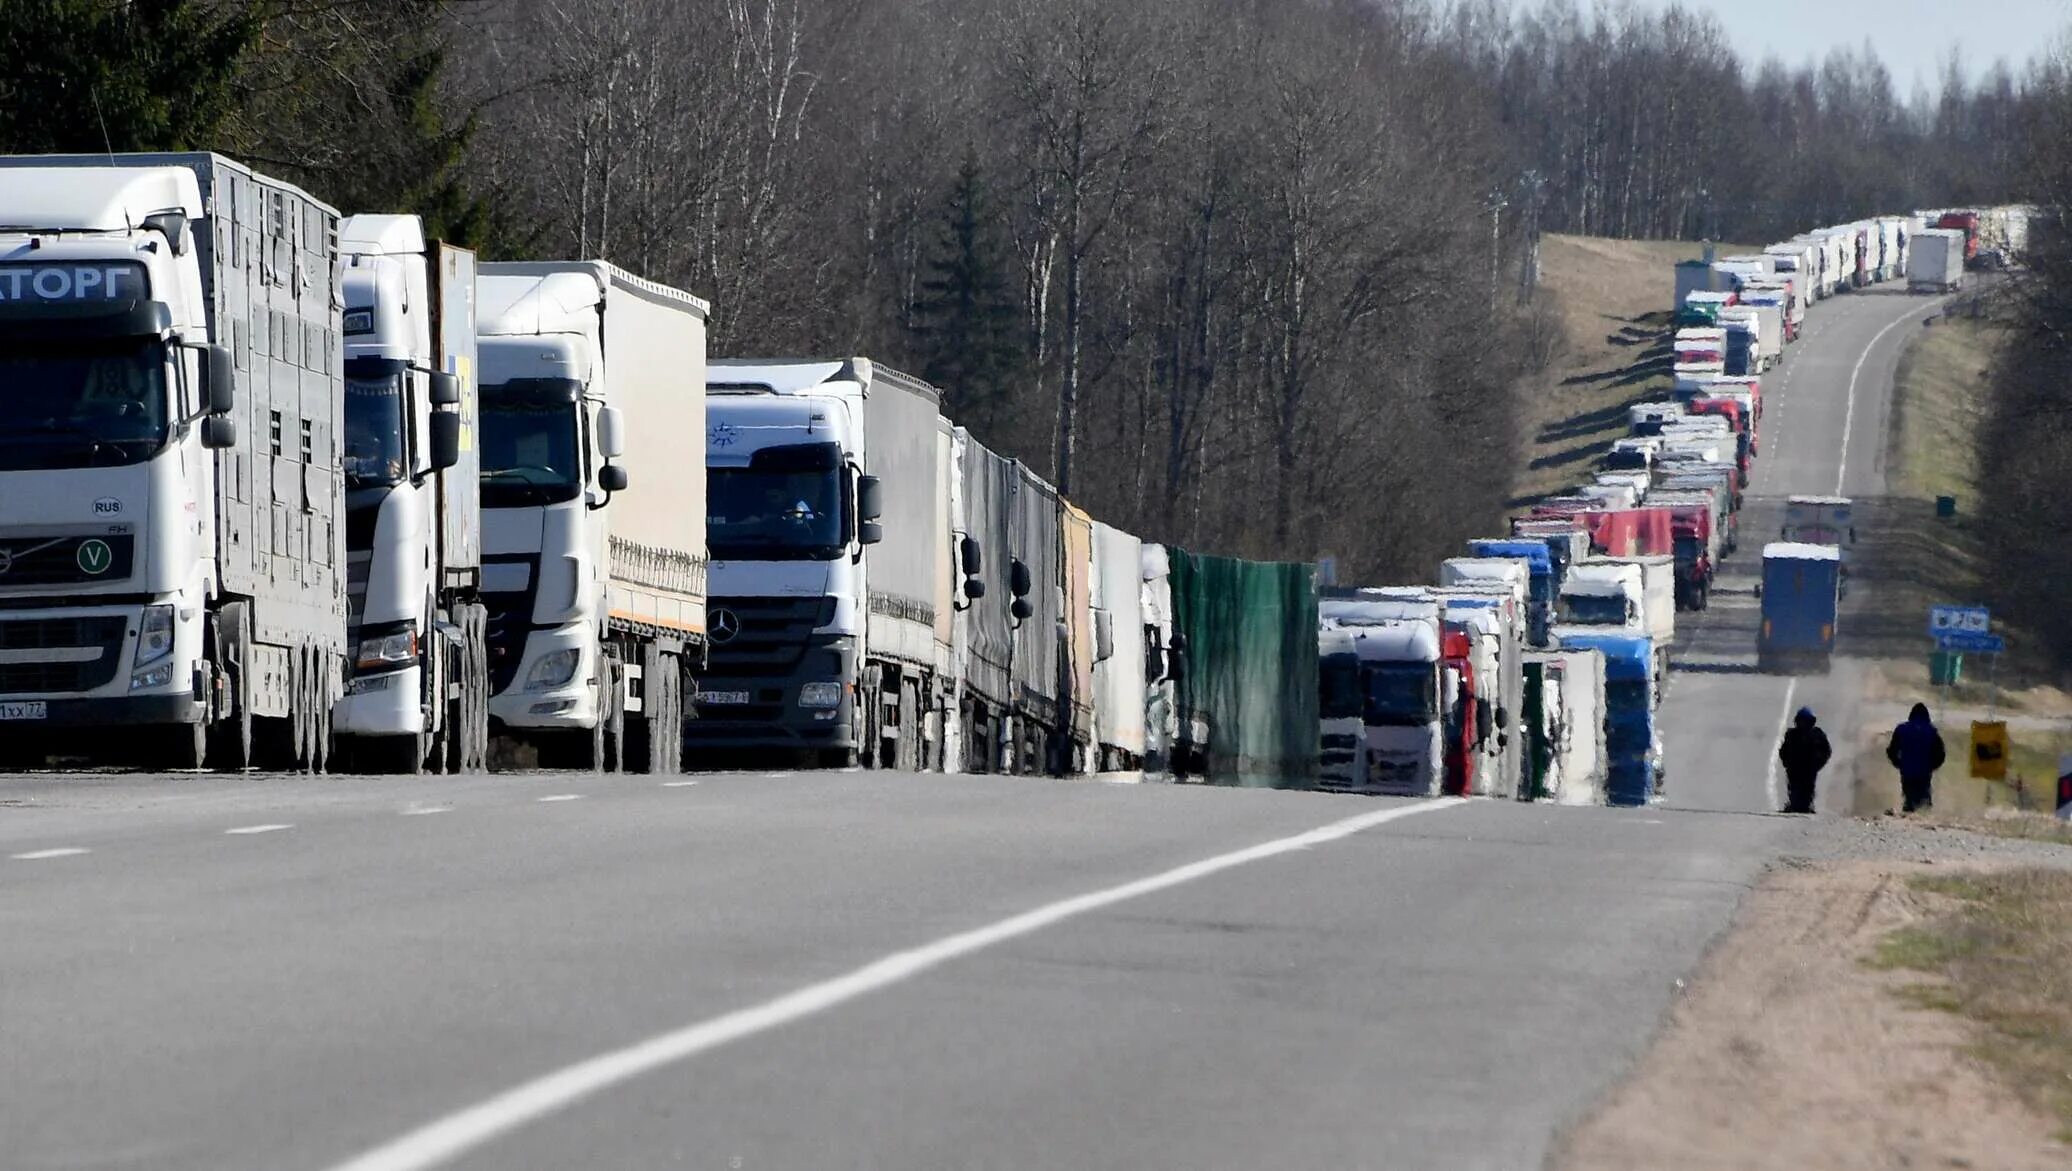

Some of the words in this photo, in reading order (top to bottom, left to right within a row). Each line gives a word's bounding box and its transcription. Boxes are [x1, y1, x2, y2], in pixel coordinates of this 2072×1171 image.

[0, 267, 131, 299] ТОРГ
[94, 502, 121, 513] RUS
[86, 546, 101, 566] V
